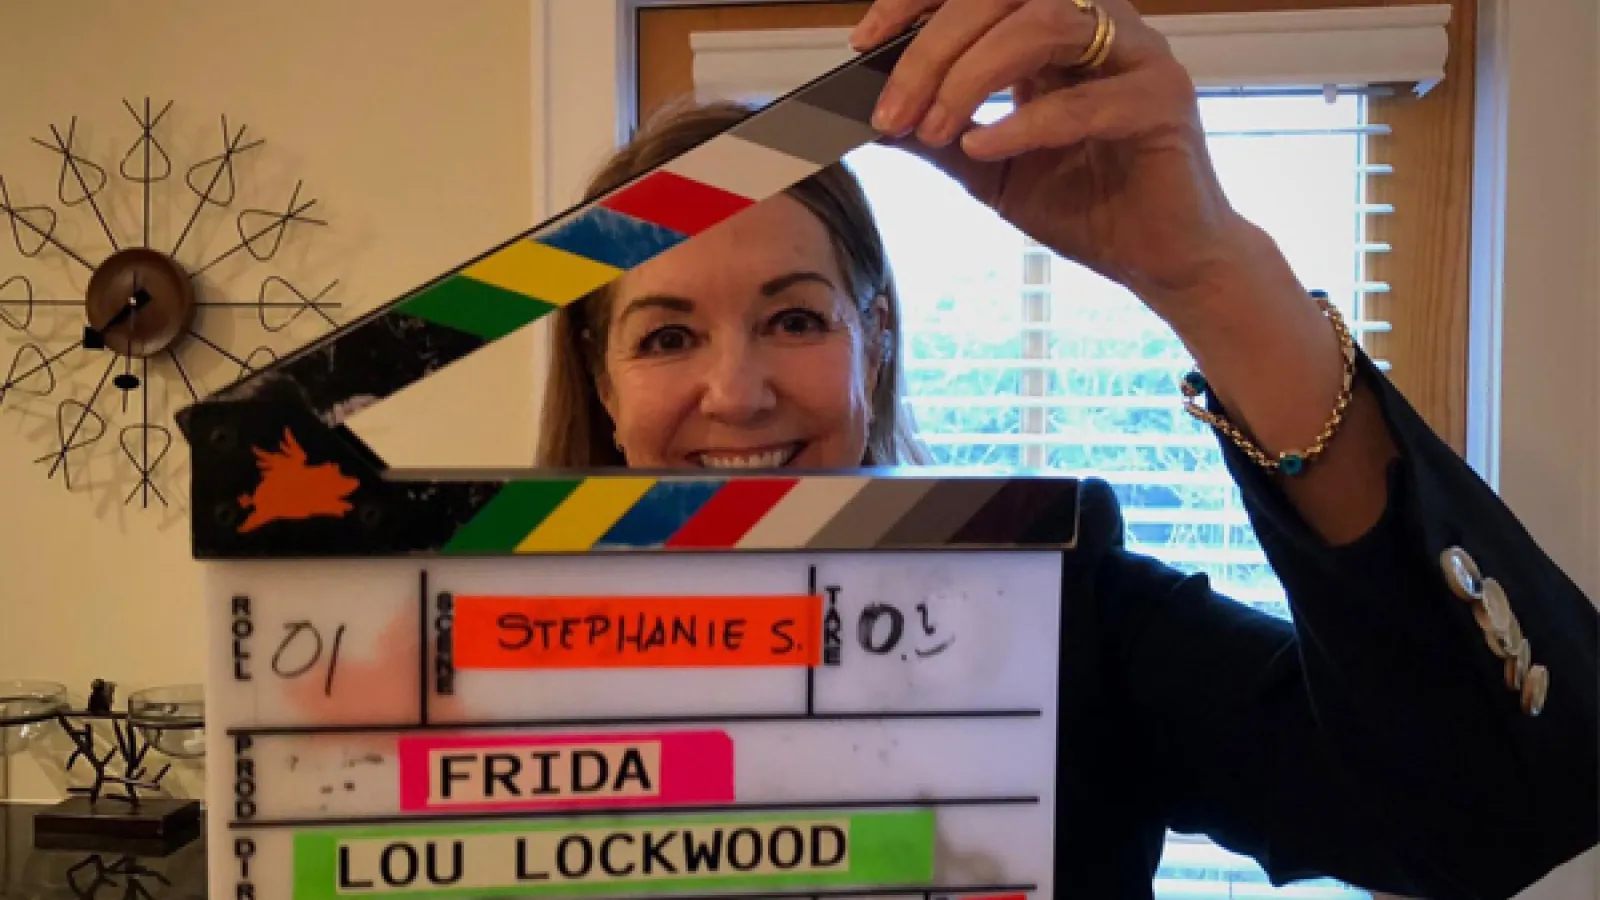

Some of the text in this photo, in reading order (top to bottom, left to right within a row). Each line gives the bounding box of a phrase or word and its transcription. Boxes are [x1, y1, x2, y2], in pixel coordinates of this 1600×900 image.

[231, 595, 253, 681] ROLL
[496, 612, 747, 654] STEPHANIE
[438, 747, 653, 800] FRIDA
[338, 825, 847, 889] LOU LOCKWOOD
